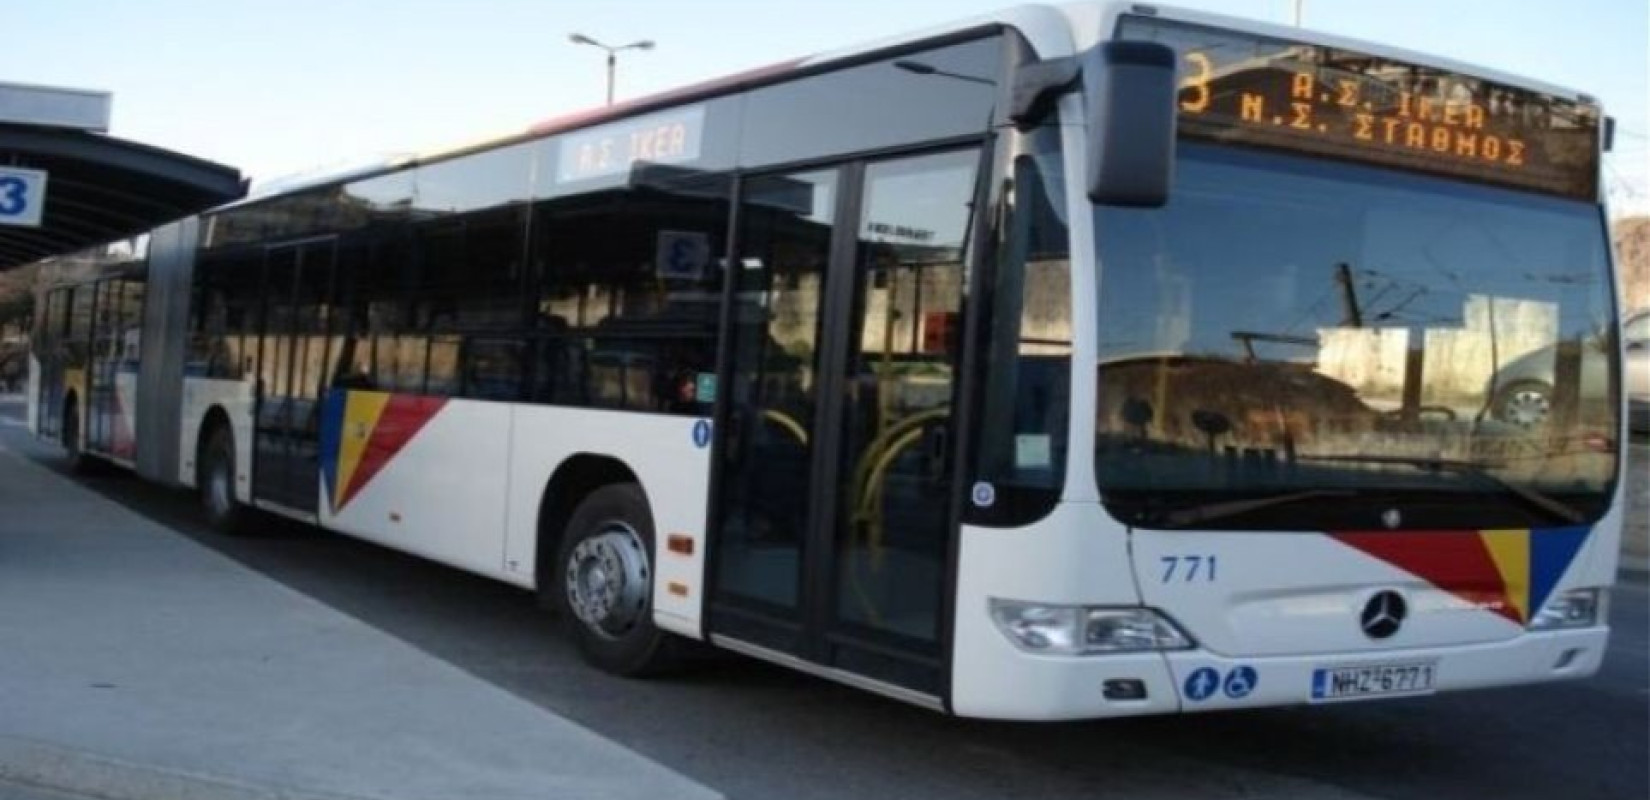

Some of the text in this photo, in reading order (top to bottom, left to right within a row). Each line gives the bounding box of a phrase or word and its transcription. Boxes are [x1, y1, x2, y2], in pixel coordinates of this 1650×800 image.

[1354, 113, 1526, 165] ΣΤΑΘΜΟΣ
[0, 176, 27, 216] 3
[1160, 556, 1216, 584] 771
